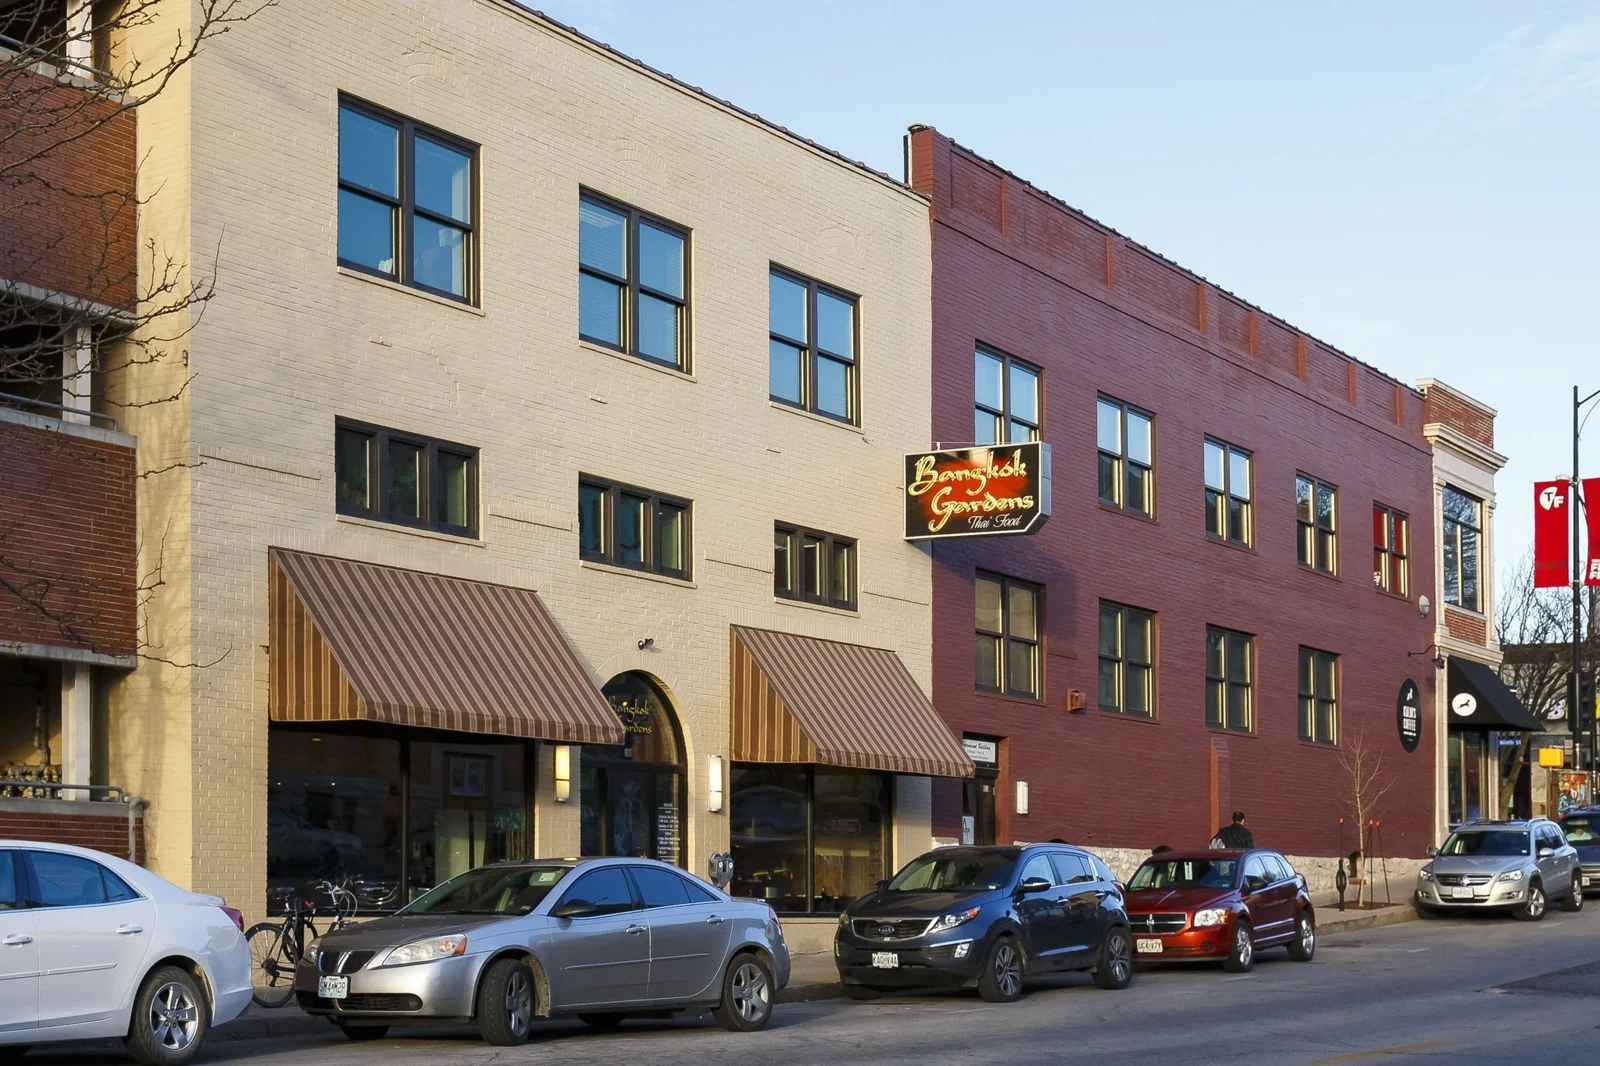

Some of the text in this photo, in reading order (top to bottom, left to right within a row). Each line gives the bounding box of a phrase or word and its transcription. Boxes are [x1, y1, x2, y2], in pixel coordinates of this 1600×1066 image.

[908, 449, 1027, 496] Bangkok
[928, 486, 1034, 532] Gardens
[968, 513, 1022, 530] Thai Food
[625, 722, 652, 735] ardens
